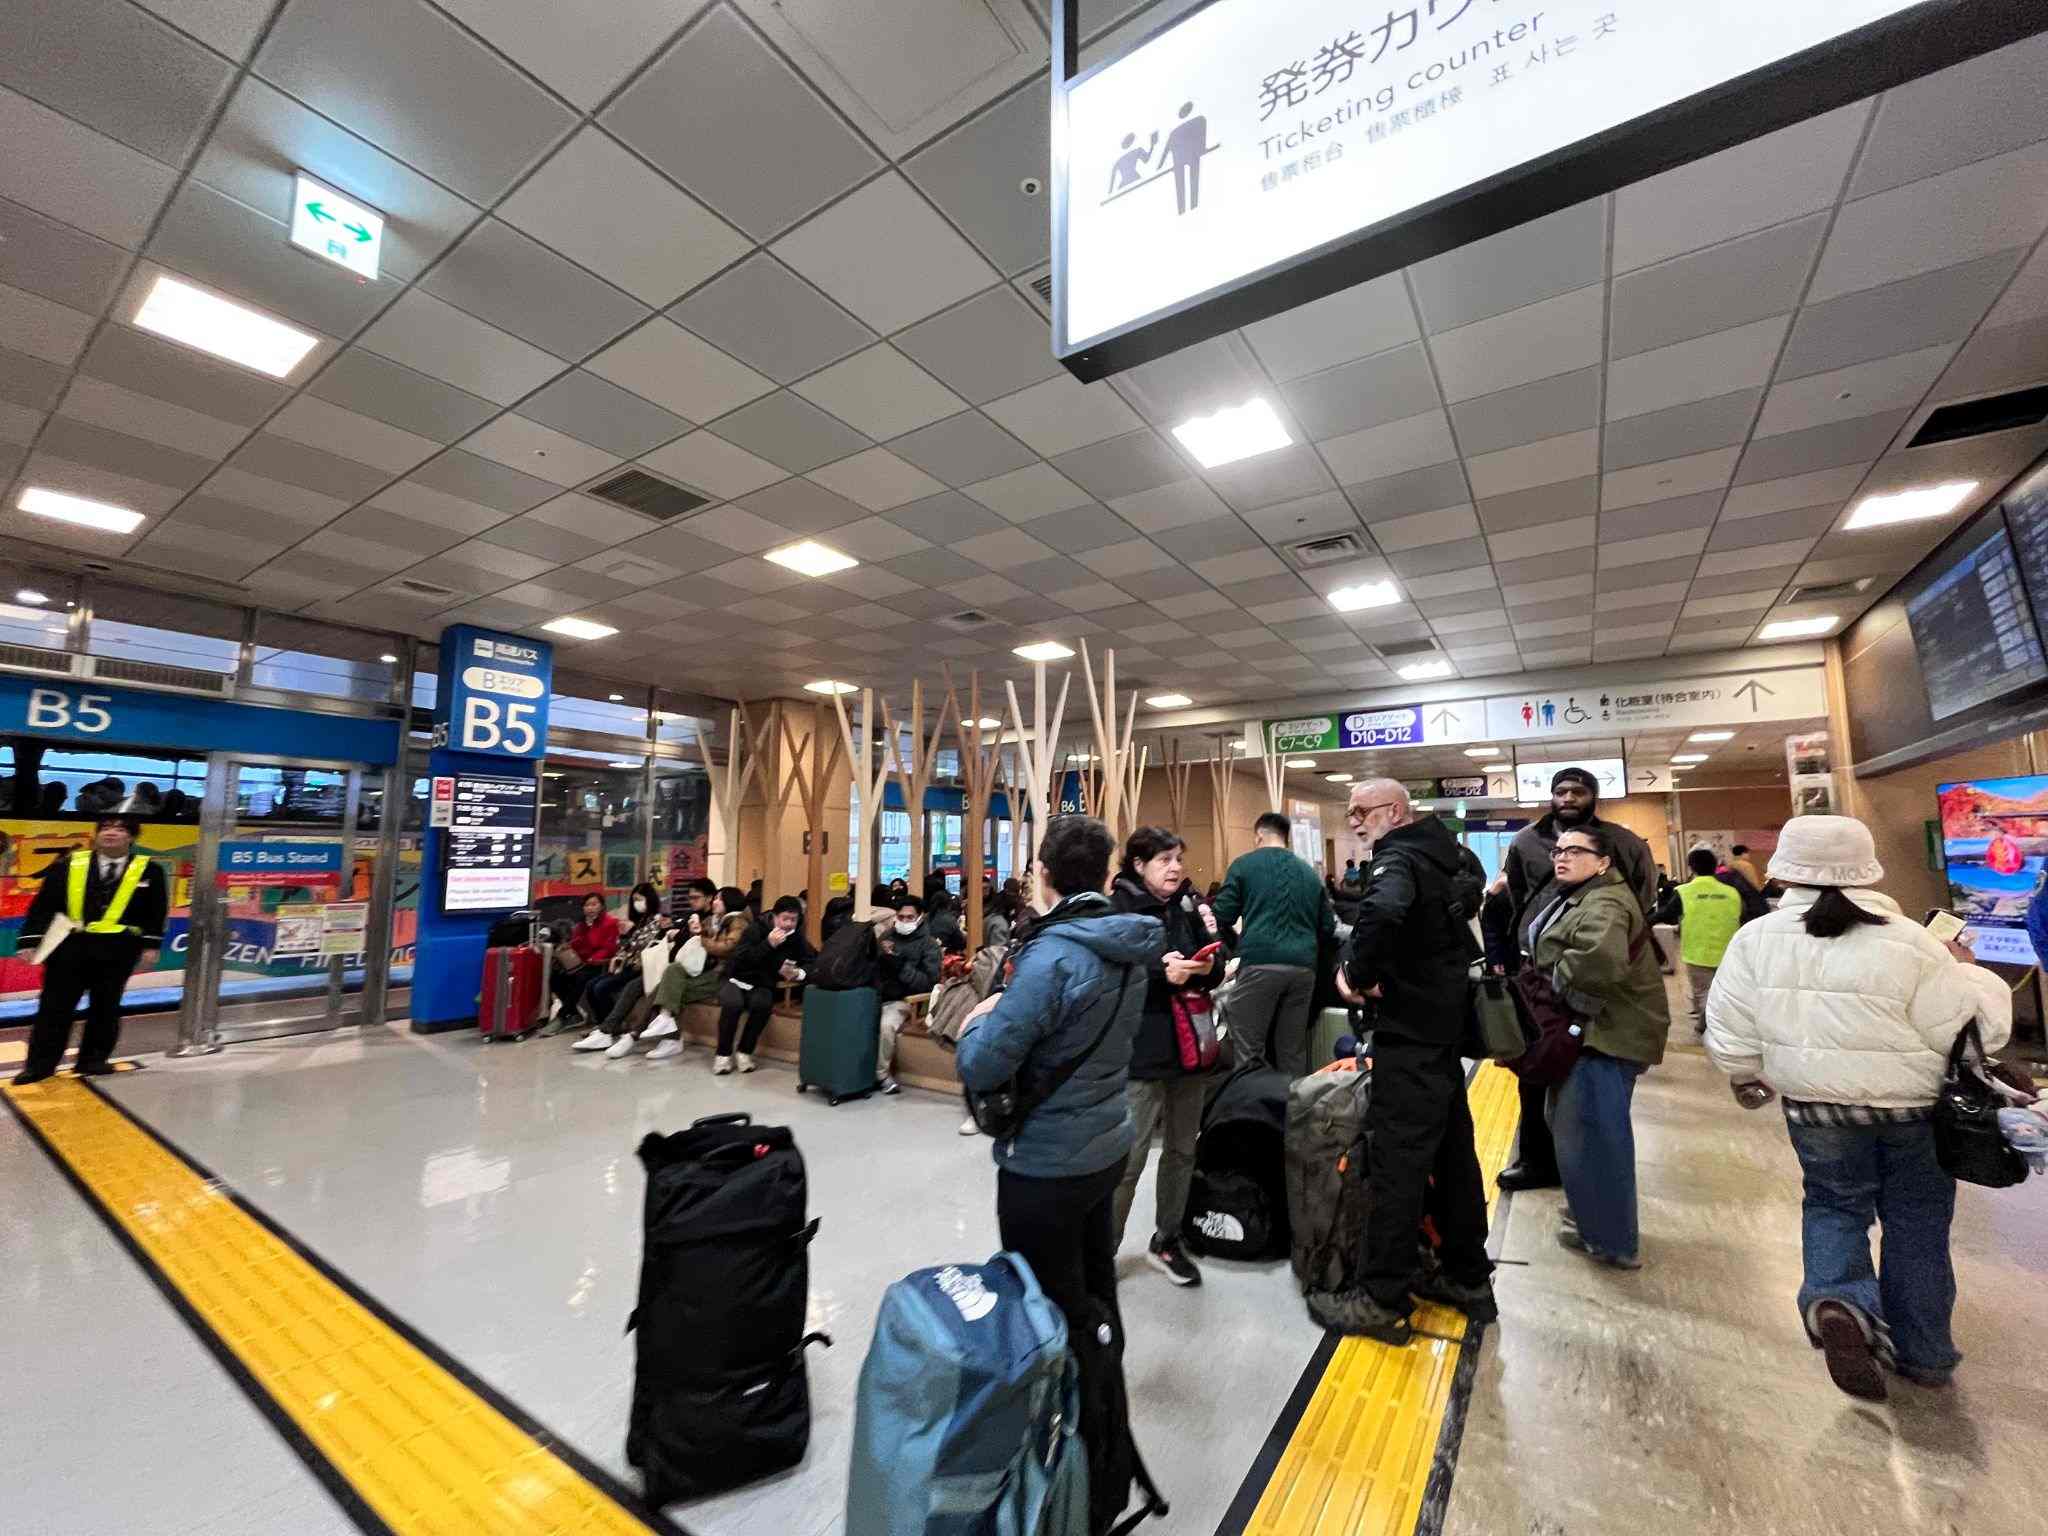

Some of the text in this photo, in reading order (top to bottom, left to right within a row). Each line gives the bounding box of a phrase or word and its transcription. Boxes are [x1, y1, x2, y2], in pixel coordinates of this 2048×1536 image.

[1258, 12, 1545, 161] Ticketing counter
[27, 688, 113, 733] B5
[462, 696, 537, 754] B5
[432, 721, 449, 748] B5
[1061, 799, 1076, 813] B6
[231, 850, 330, 864] B5 Bus Stand
